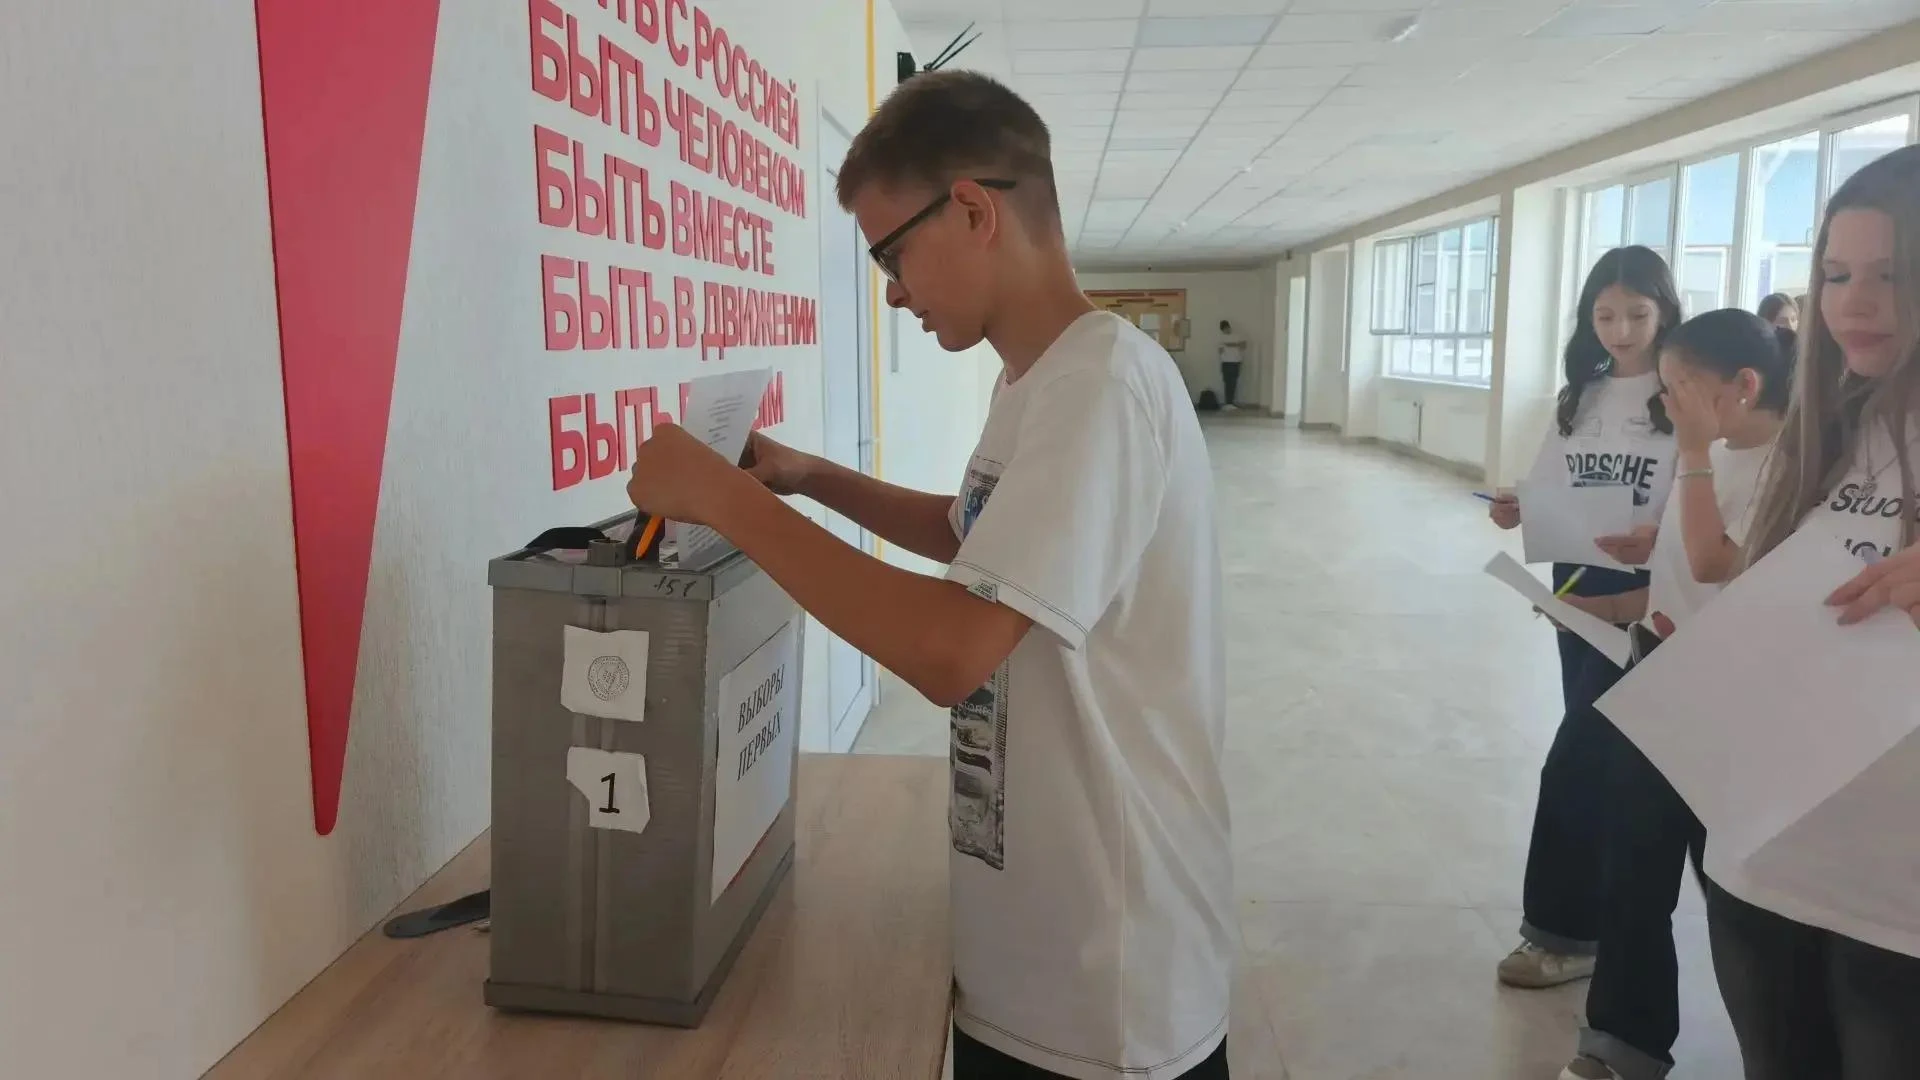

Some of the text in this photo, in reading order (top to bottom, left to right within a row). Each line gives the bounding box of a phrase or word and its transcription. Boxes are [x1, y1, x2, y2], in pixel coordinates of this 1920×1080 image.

[528, 0, 806, 219] БЫТЬ ЧЕЛОВЕКОМ
[665, 0, 689, 67] С
[694, 6, 800, 150] РОССИЕЙ
[534, 124, 775, 276] БЫТЬ ВМЕСТЕ
[541, 254, 817, 361] БЫТЬ В ДВИЖЕНИИ
[1565, 452, 1658, 490] PORSCHE
[737, 663, 785, 734] ВЫБОРЫ
[736, 710, 782, 781] ПЕРВЫХ
[598, 772, 620, 814] 1
